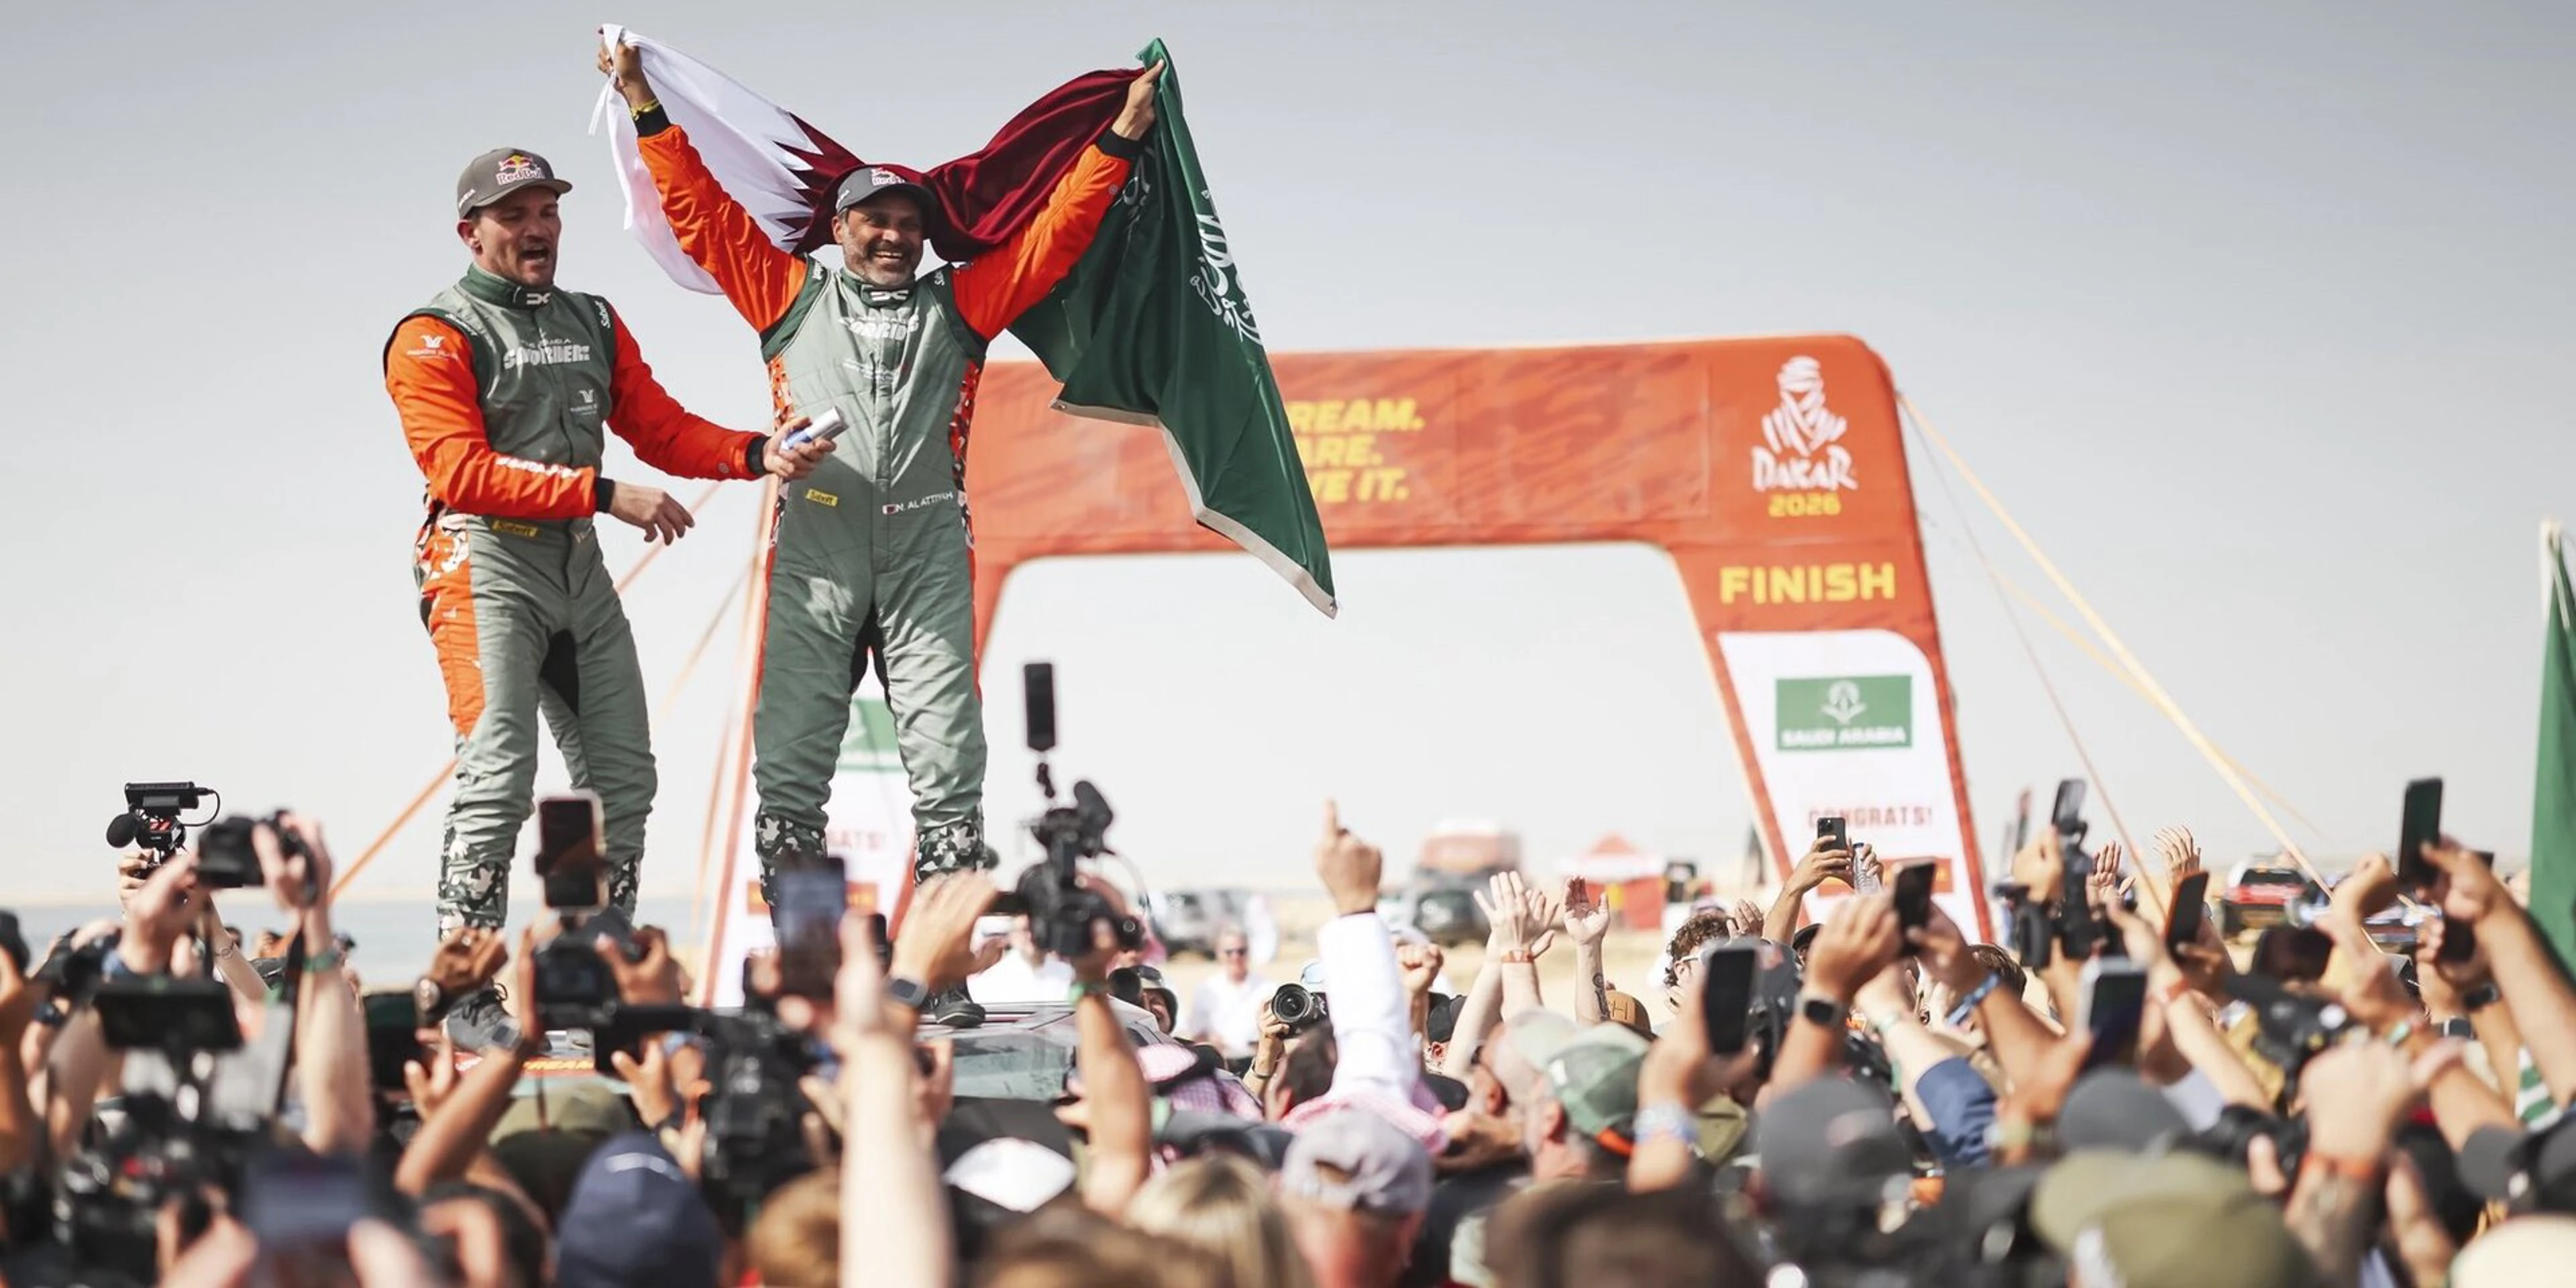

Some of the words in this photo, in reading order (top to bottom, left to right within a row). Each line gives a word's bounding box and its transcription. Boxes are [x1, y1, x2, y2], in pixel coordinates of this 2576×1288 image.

[1284, 398, 1426, 432] REAM.
[1295, 434, 1384, 468] ARE.
[1751, 445, 1858, 492] DAKAR
[1356, 470, 1409, 502] IT.
[1768, 492, 1841, 517] 2026
[1719, 562, 1896, 604] FINISH
